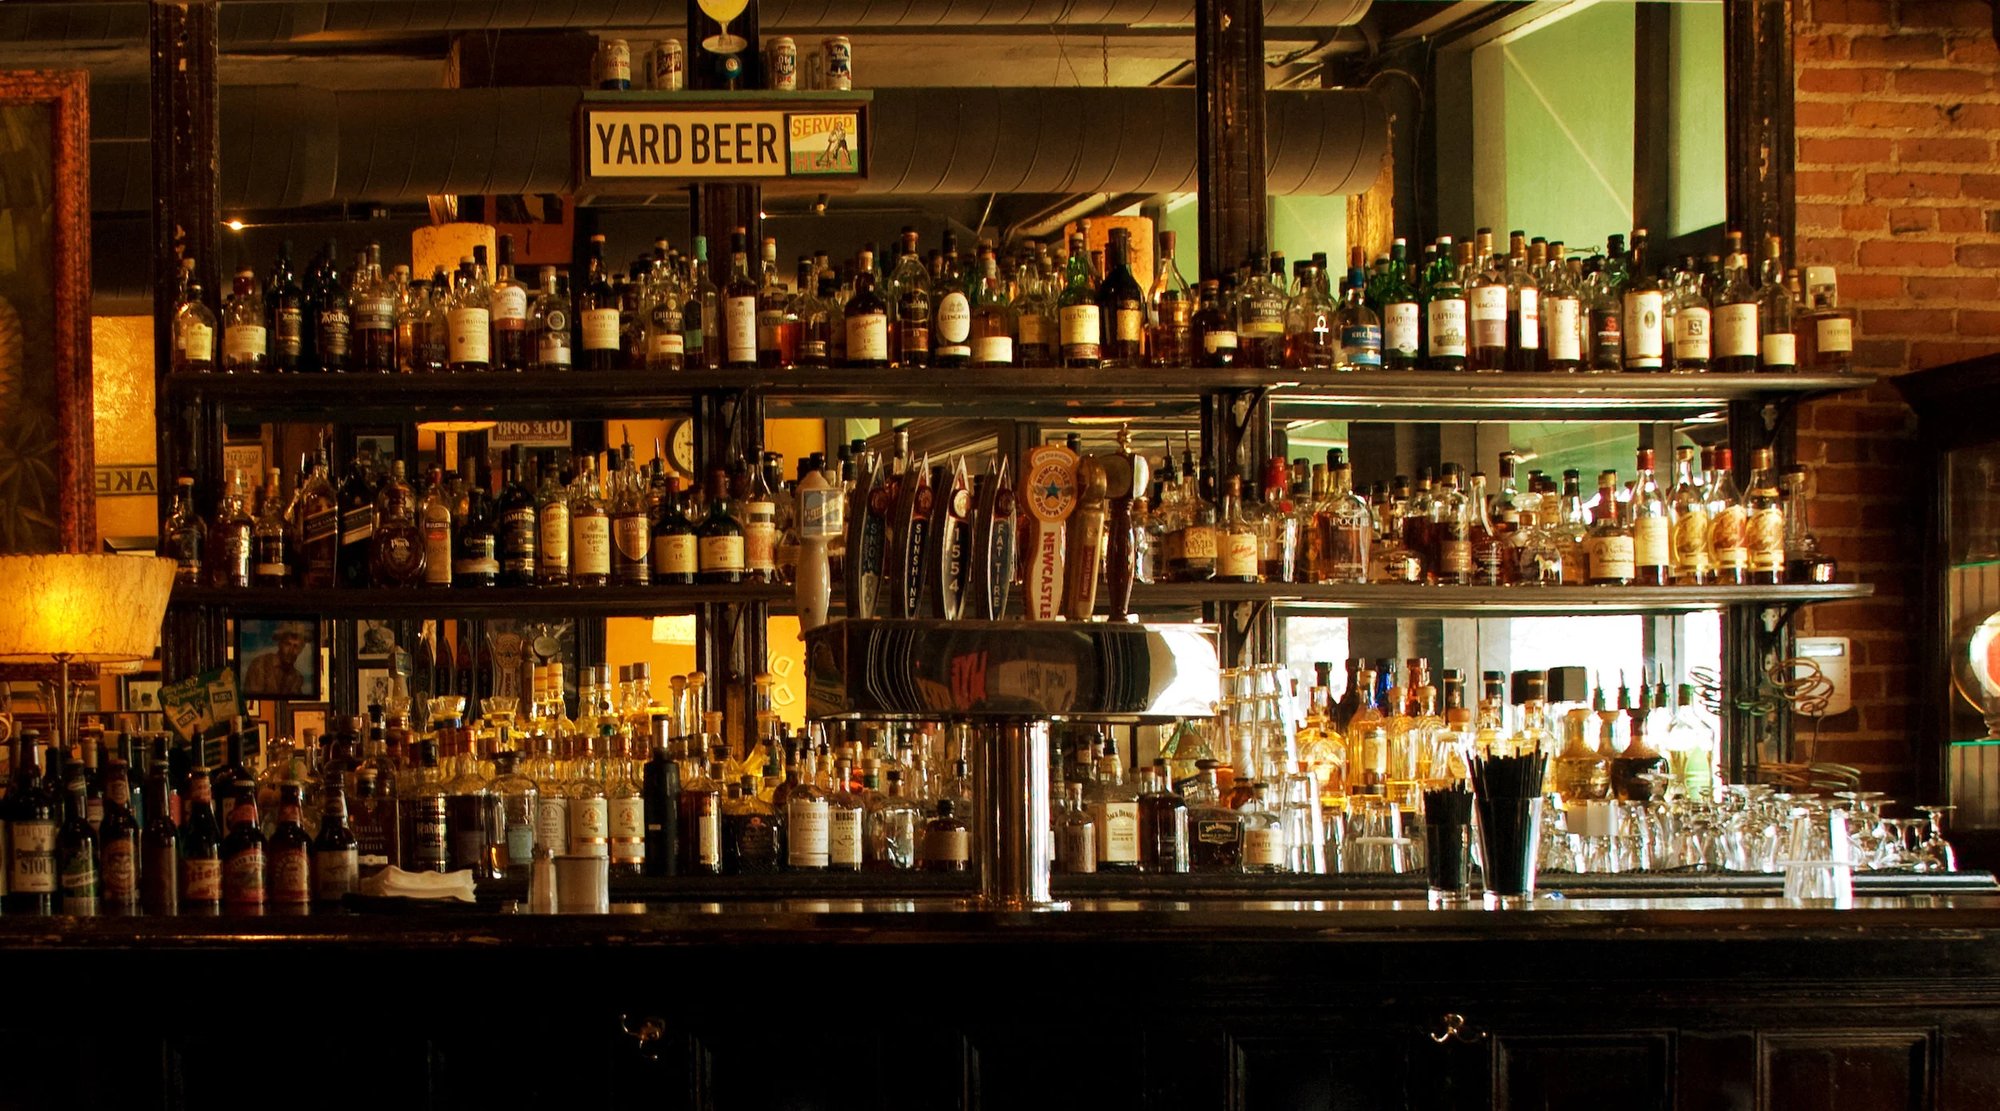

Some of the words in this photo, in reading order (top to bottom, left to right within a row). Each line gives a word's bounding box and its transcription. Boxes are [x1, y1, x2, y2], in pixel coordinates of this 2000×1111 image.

[596, 123, 682, 165] YARD
[691, 123, 778, 165] BEER
[792, 116, 852, 137] SERVED
[1036, 465, 1071, 485] NEWCASTLE
[1035, 497, 1059, 516] BROWN
[1059, 497, 1069, 512] ALE
[995, 525, 1004, 557] FAT
[909, 523, 921, 608] SUNSHINE
[949, 528, 960, 592] 1554
[1039, 531, 1055, 619] NEWCASTLE
[993, 562, 1002, 607] TIRE
[836, 812, 857, 822] HIRSC
